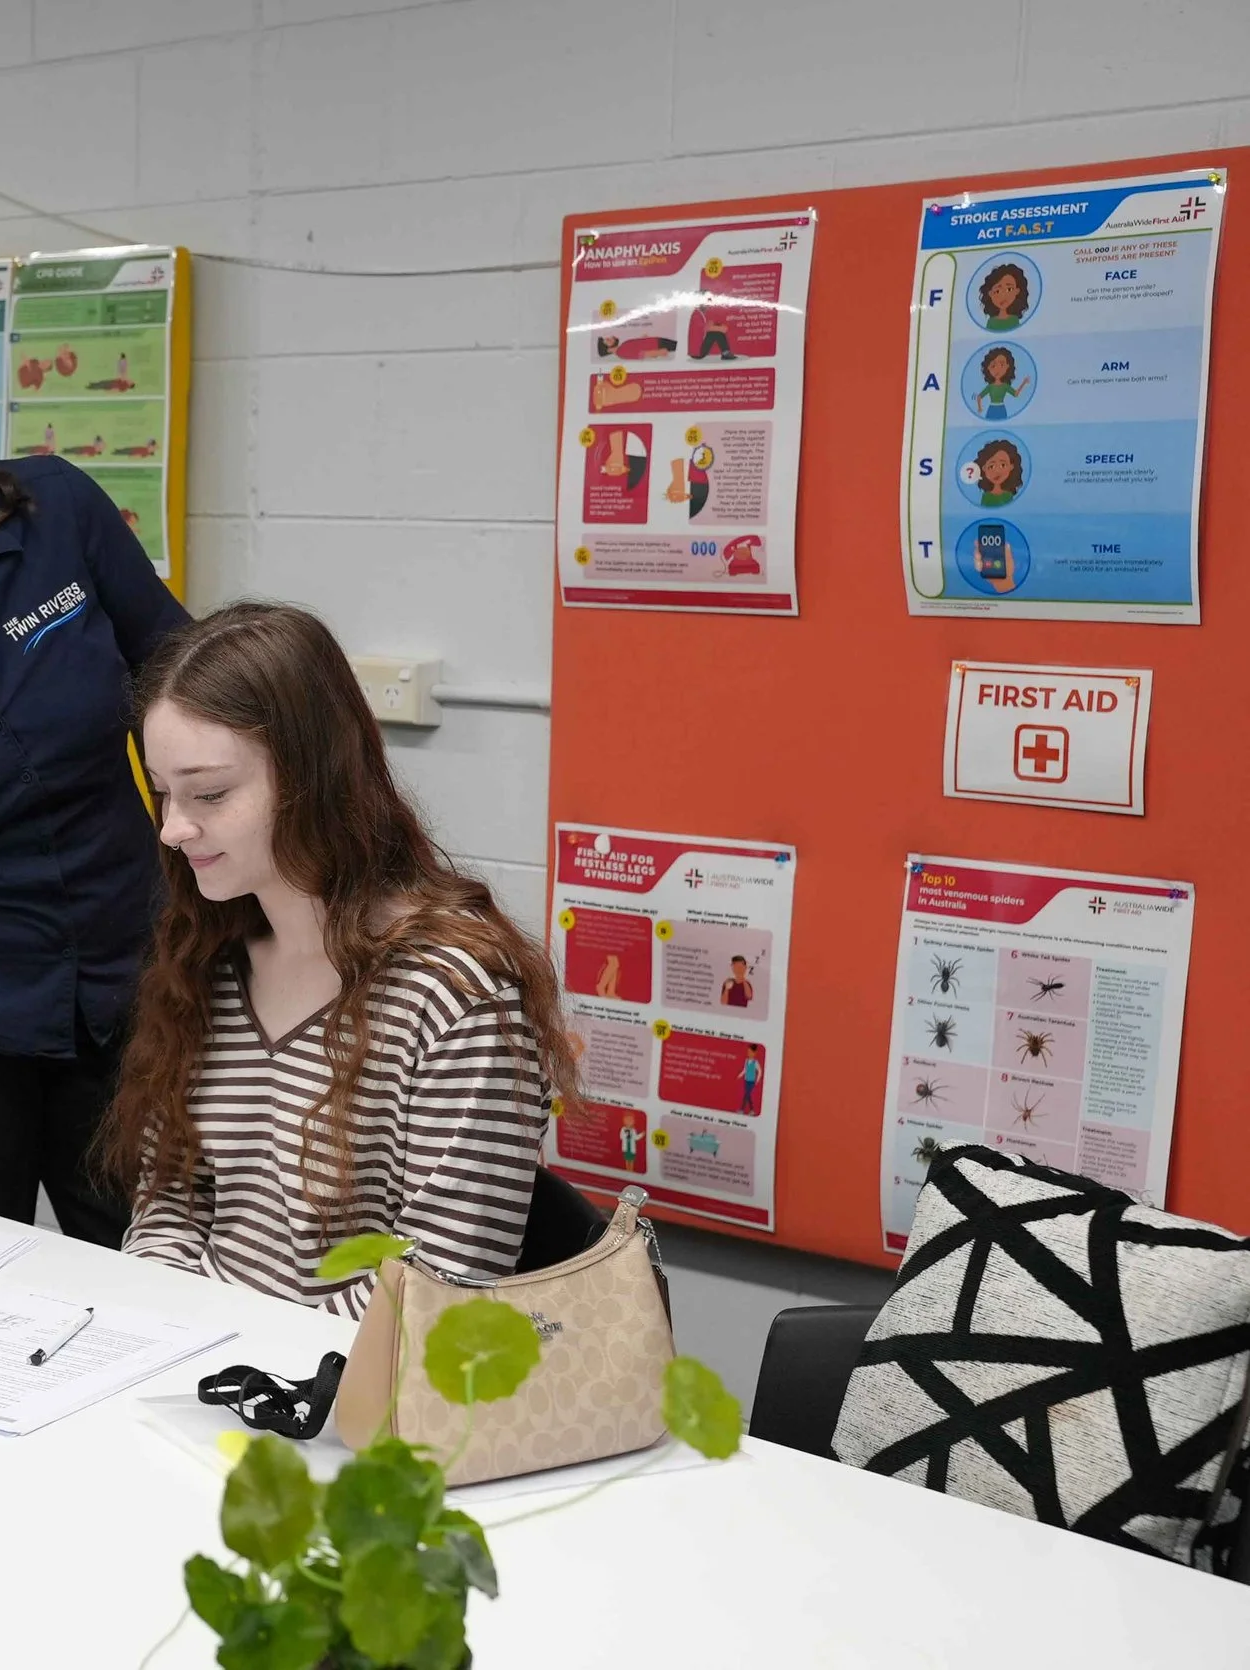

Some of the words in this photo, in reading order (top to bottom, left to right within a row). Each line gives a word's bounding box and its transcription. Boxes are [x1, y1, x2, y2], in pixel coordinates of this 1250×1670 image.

[951, 211, 998, 226] STROKE
[1000, 202, 1088, 221] ASSESSMENT
[977, 228, 1002, 239] ACT
[1005, 222, 1054, 237] F.A.S.T
[585, 242, 680, 260] ANAPHYLAXIS
[1074, 248, 1092, 256] CALL
[1120, 244, 1137, 252] ANY
[1152, 241, 1178, 249] THESE
[584, 261, 601, 269] How
[603, 261, 611, 269] to
[640, 256, 667, 267] EpiPen
[1076, 254, 1119, 264] SYMPTOMS
[1139, 250, 1176, 259] PRESENT
[1105, 270, 1137, 281] FACE
[1112, 286, 1135, 294] person
[1142, 290, 1174, 298] drooped?
[930, 290, 943, 307] F
[1101, 361, 1130, 372] ARM
[922, 374, 940, 391] A
[1086, 454, 1134, 464] SPEECH
[920, 459, 933, 476] S
[966, 468, 974, 479] ?
[982, 536, 1001, 546] 000
[692, 542, 717, 556] 000
[918, 542, 933, 558] T
[1092, 544, 1121, 554] TIME
[60, 591, 87, 614] CENTRE
[6, 612, 41, 642] TWIN
[38, 582, 81, 619] RIVERS
[2, 616, 19, 632] THE
[978, 684, 1057, 710] FIRST
[1062, 689, 1118, 713] AID
[577, 847, 606, 859] FIRST
[609, 852, 628, 862] AID
[630, 854, 655, 865] FOR
[574, 856, 625, 872] RESTLESS
[628, 864, 656, 876] LEGS
[584, 868, 644, 885] SYNDROME
[922, 872, 942, 886] Top
[944, 875, 956, 886] 10
[918, 896, 927, 905] in
[928, 898, 967, 910] Australia
[920, 886, 942, 896] most
[944, 889, 989, 902] venomous
[990, 894, 1025, 906] spiders
[914, 936, 919, 946] 1
[1011, 950, 1019, 959] 6
[908, 996, 915, 1006] 2
[1007, 1012, 1014, 1021] 7
[902, 1056, 910, 1065] 3
[1001, 1073, 1009, 1082] 8
[898, 1117, 905, 1126] 4
[996, 1135, 1003, 1145] 9
